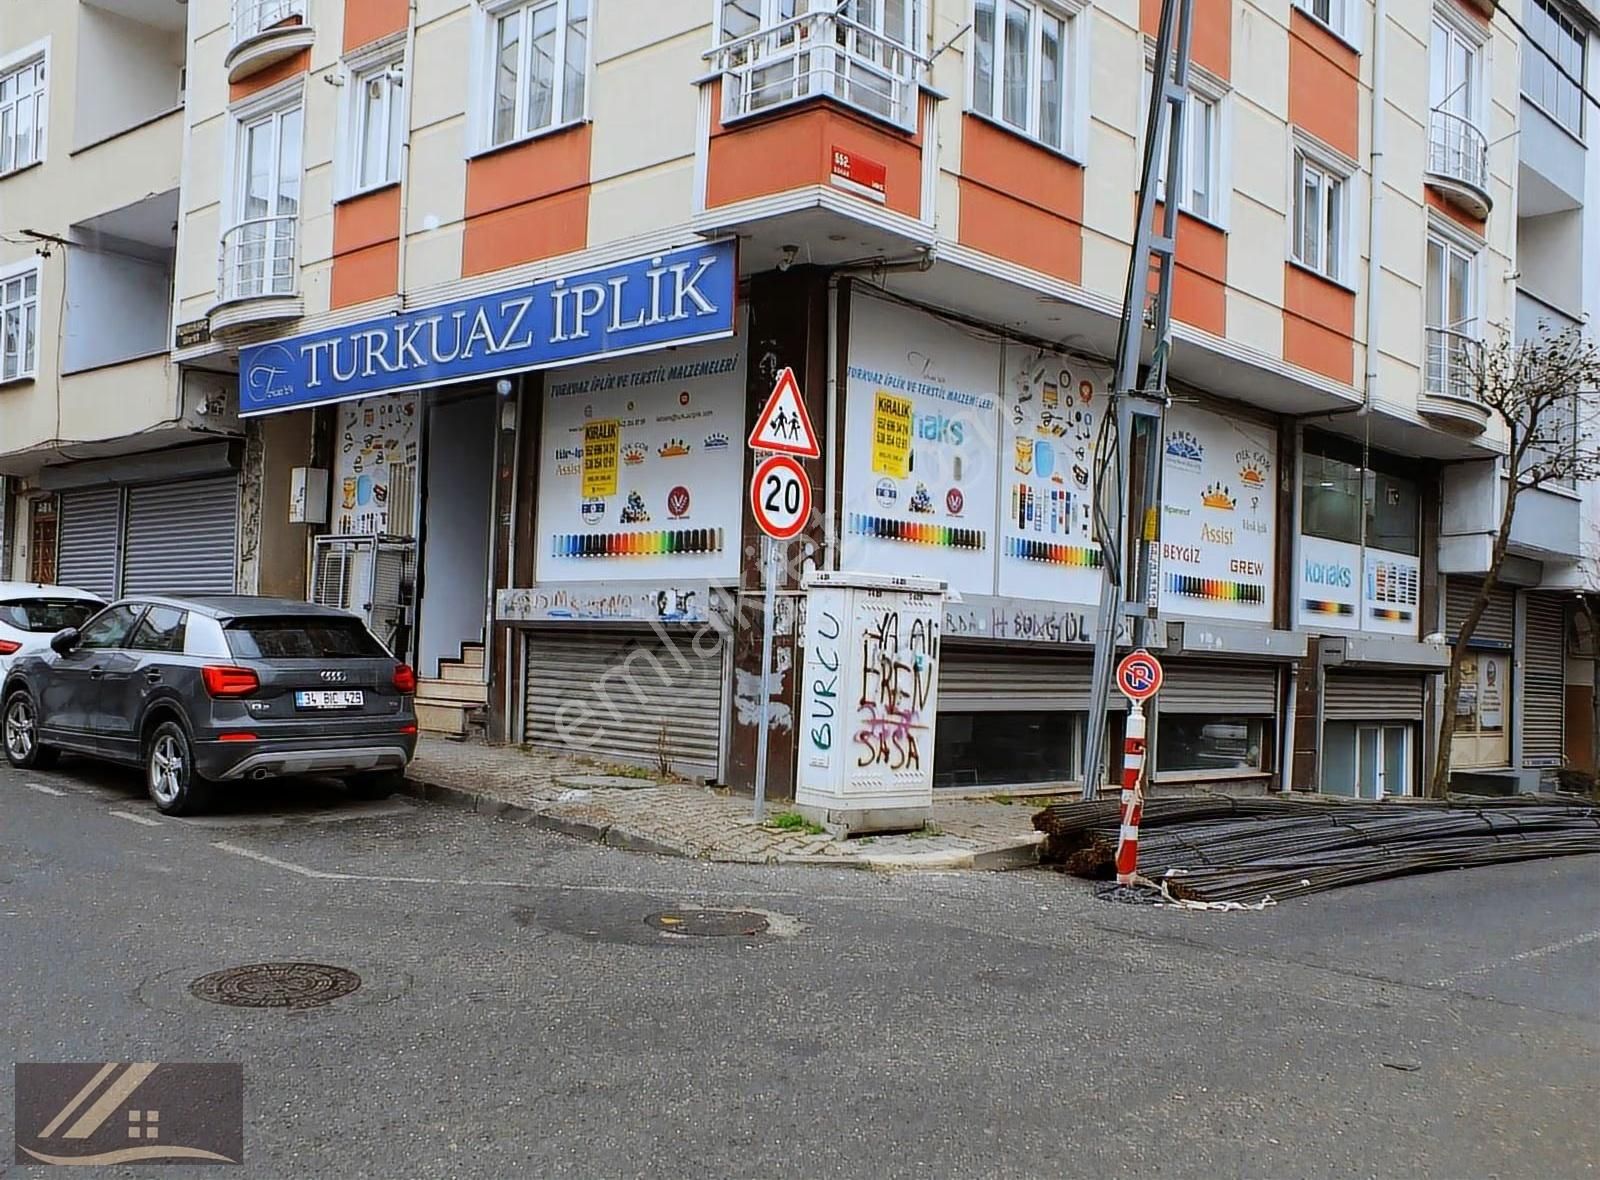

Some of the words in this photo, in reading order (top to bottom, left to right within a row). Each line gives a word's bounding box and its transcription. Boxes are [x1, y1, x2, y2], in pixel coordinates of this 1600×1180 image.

[300, 294, 535, 389] TURKUAZ
[548, 254, 719, 344] İPLİK
[550, 382, 590, 399] TURKUAZ
[764, 474, 801, 516] 20
[1201, 521, 1234, 545] Assist
[1162, 544, 1201, 564] BEYGİZ
[1230, 558, 1264, 577] GREW
[811, 612, 840, 751] BURCU
[304, 692, 317, 705] 34
